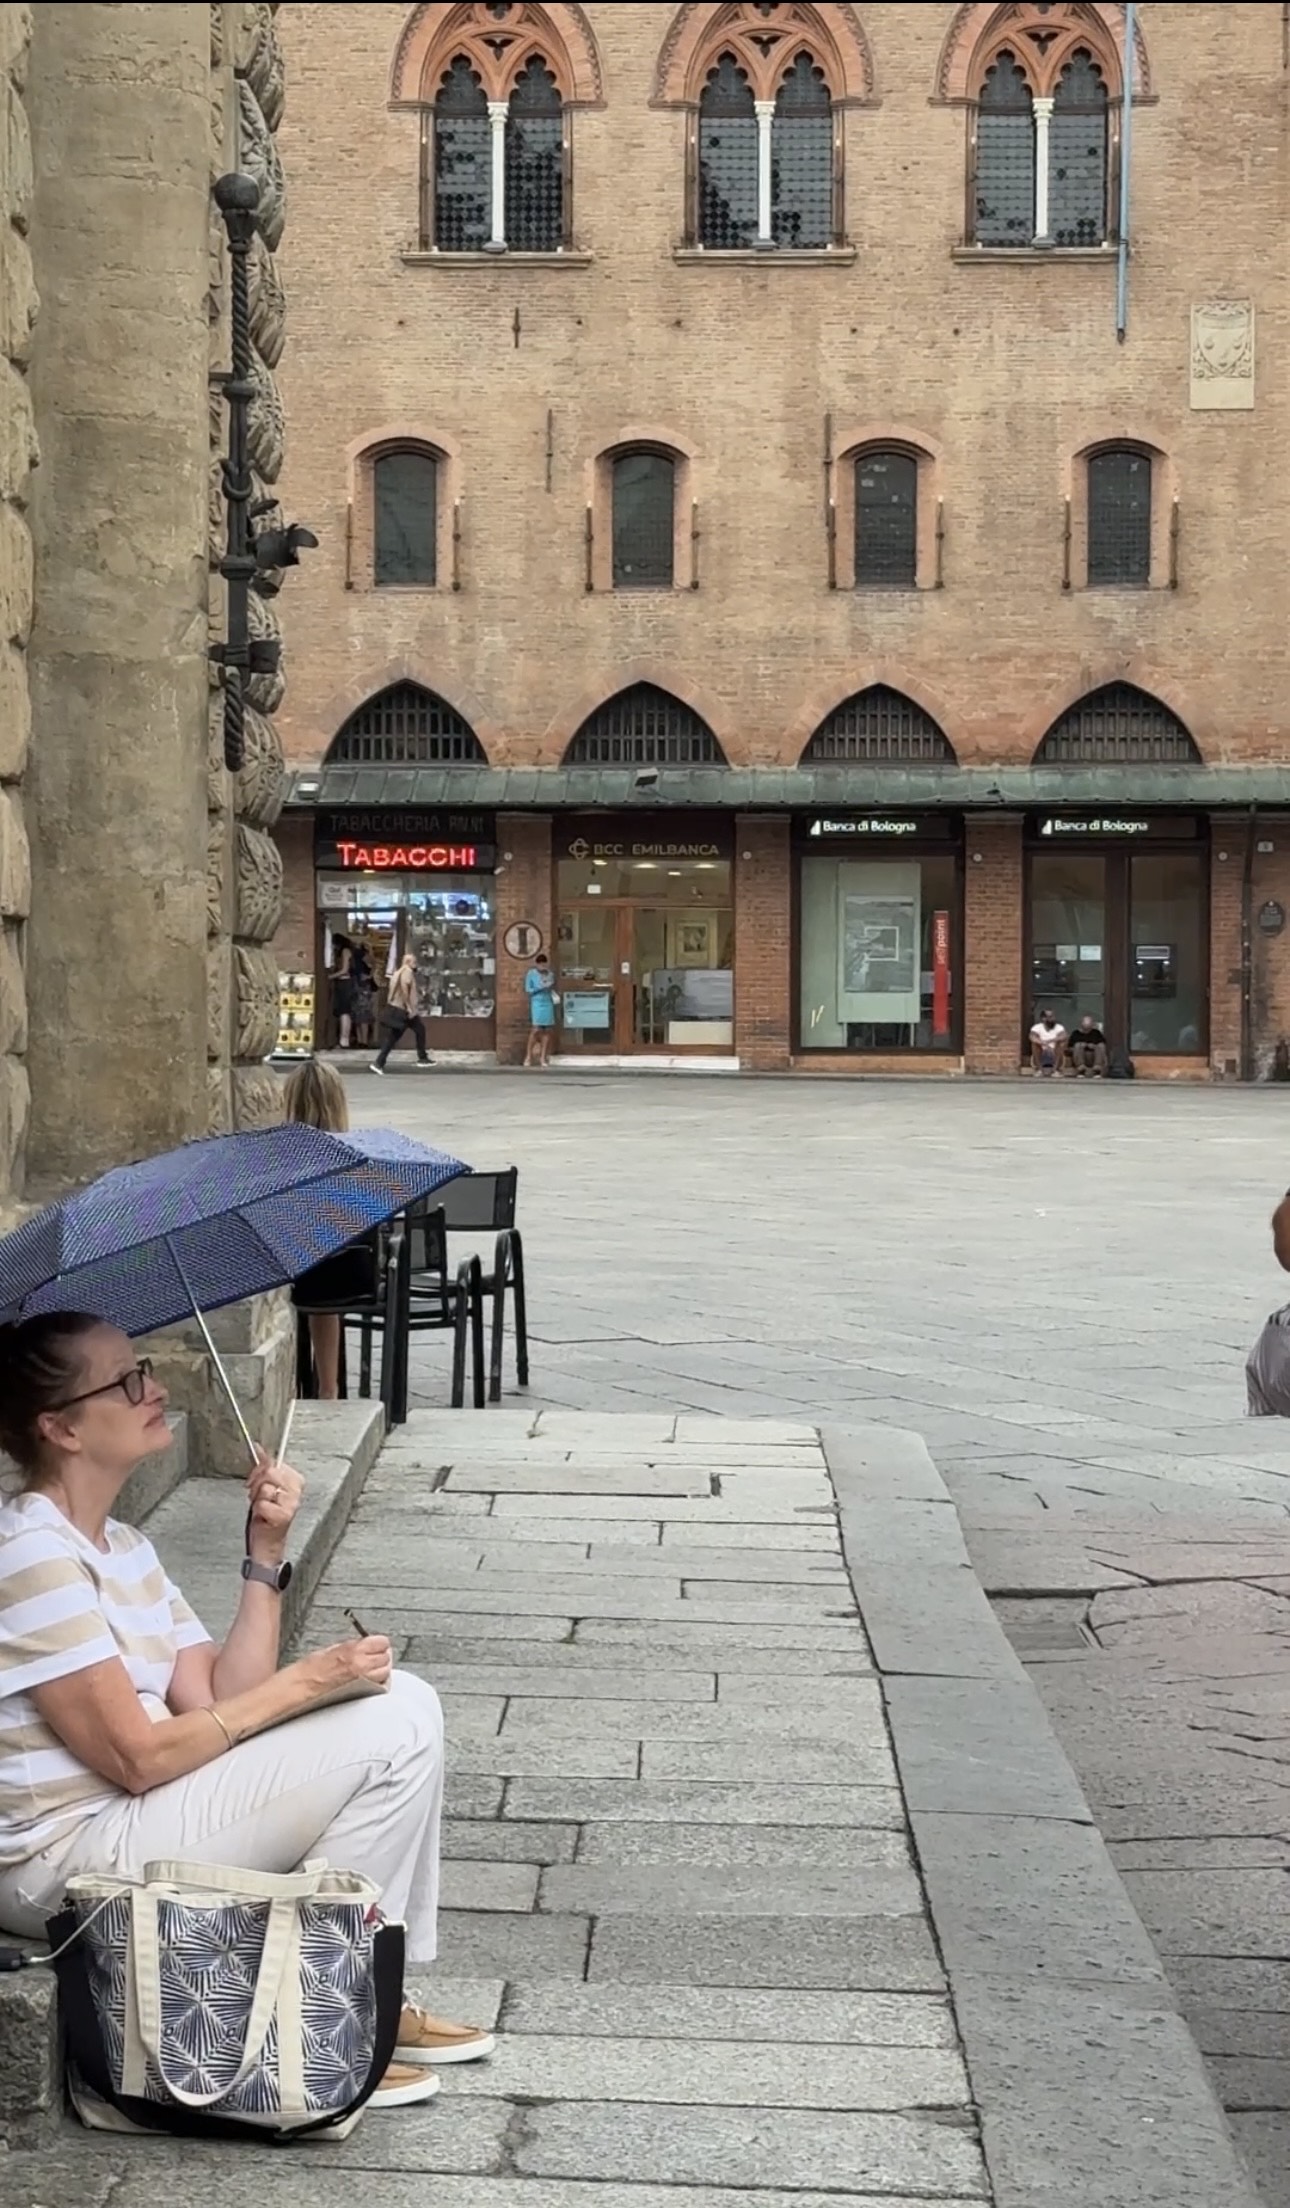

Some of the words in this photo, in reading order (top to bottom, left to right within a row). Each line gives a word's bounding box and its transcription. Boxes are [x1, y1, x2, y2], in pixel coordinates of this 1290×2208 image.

[330, 814, 440, 833] TABACCHERIA
[823, 820, 856, 832] Banca
[858, 820, 868, 832] di
[871, 820, 917, 835] Bologna
[1055, 820, 1087, 831] Banca
[1089, 820, 1100, 831] di
[1102, 820, 1149, 834] Bologna
[336, 843, 476, 867] TABACCHI
[594, 843, 624, 856] BCC
[632, 843, 720, 856] EMILBANCA
